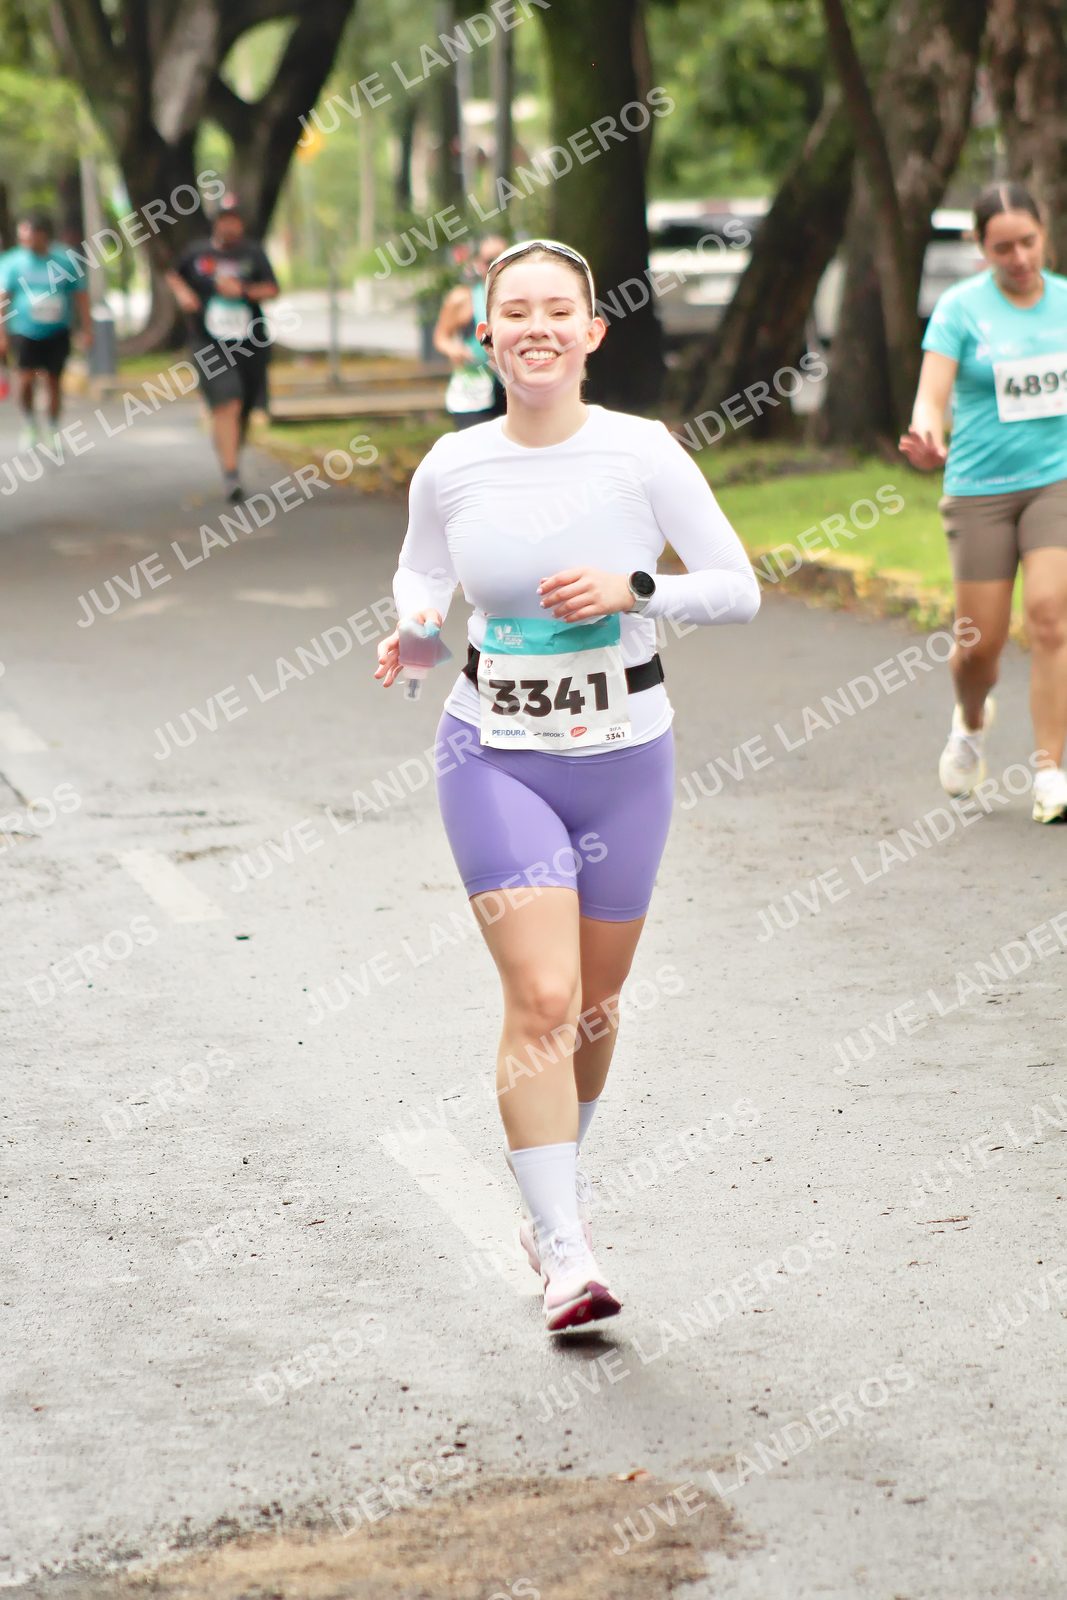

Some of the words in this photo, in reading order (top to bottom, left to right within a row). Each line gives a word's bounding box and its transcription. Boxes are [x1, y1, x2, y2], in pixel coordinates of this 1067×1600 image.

[489, 672, 609, 718] 3341
[491, 729, 527, 738] PERDURA
[605, 731, 625, 741] 3341
